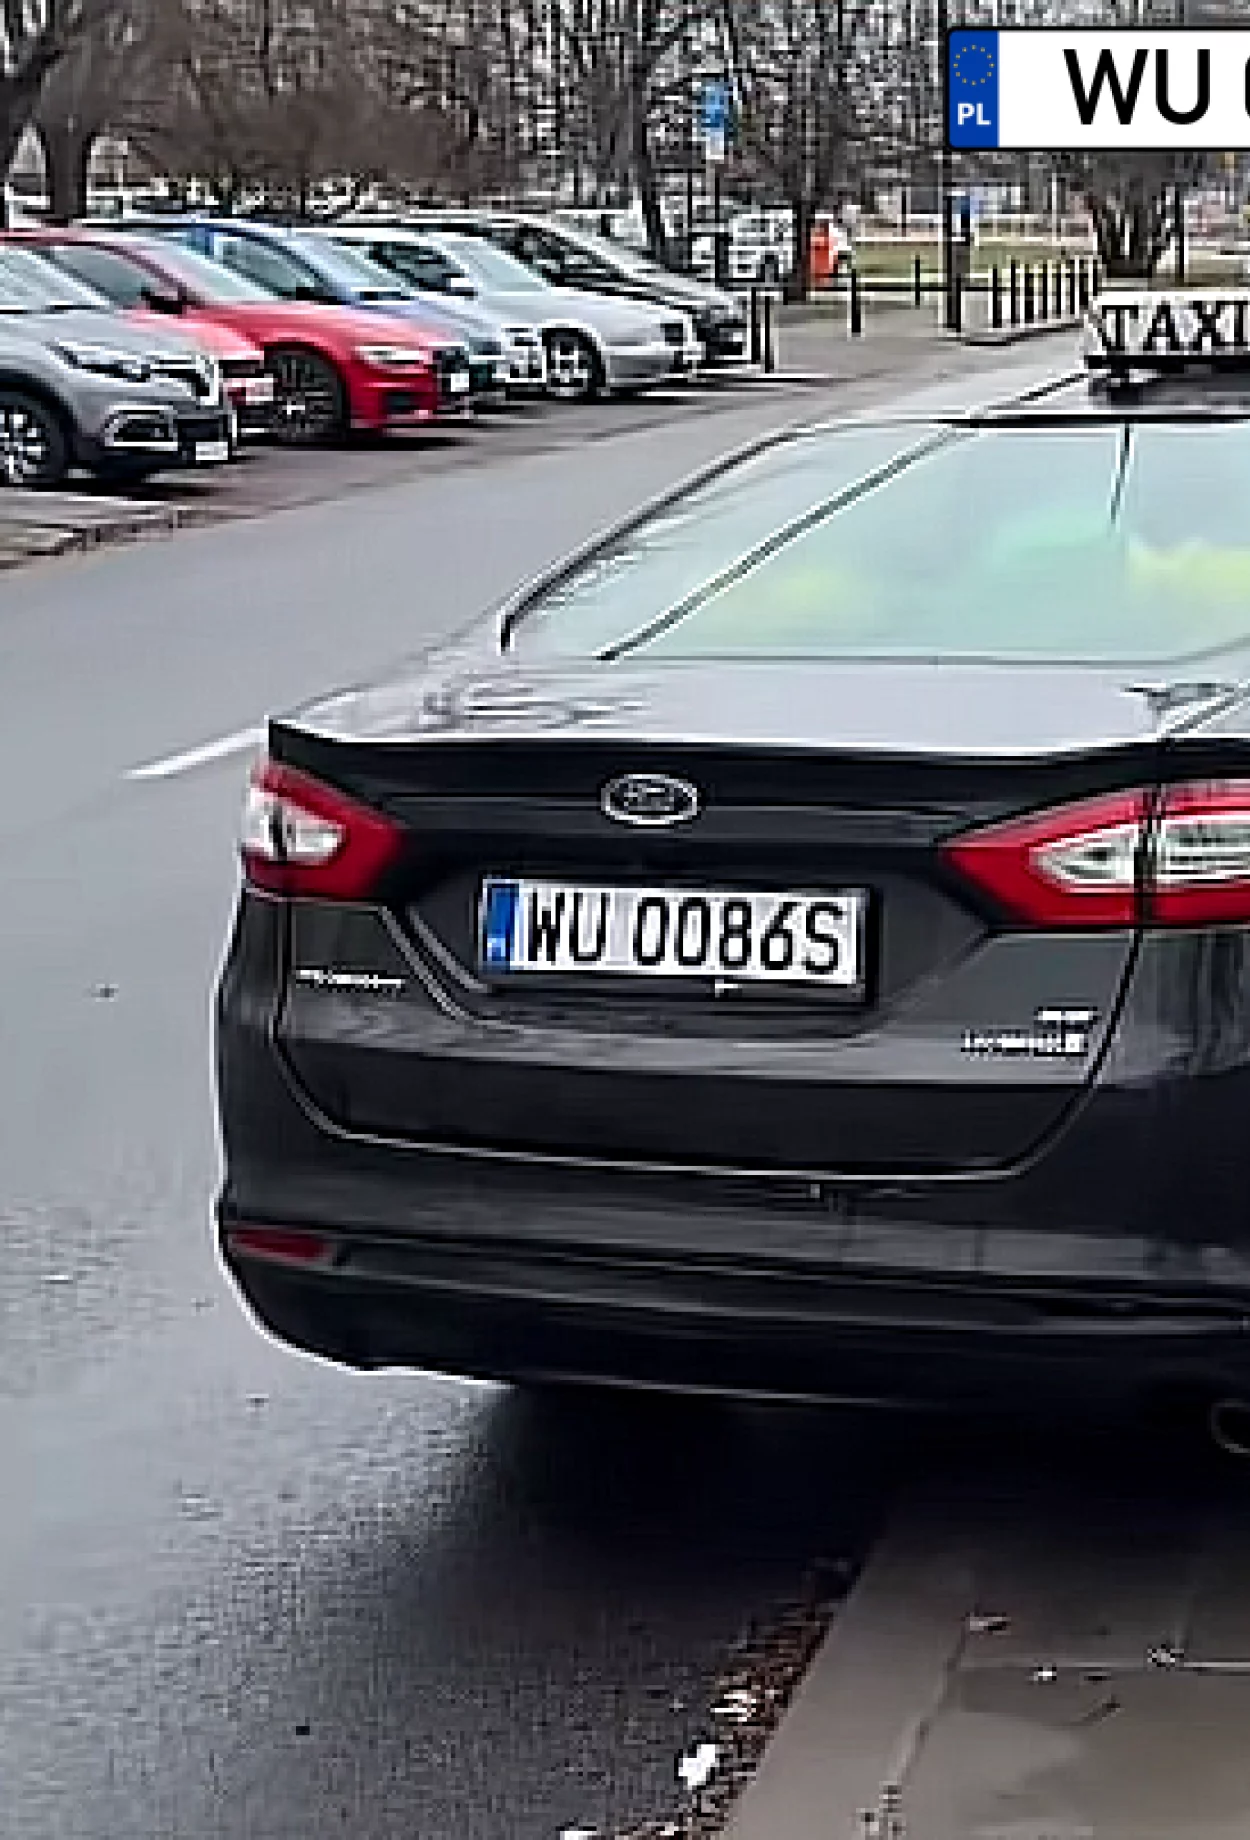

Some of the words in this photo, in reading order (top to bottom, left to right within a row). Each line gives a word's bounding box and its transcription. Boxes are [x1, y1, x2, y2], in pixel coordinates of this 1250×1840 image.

[1100, 300, 1250, 352] TAXI
[527, 891, 610, 966] WU
[633, 896, 844, 975] 0086S
